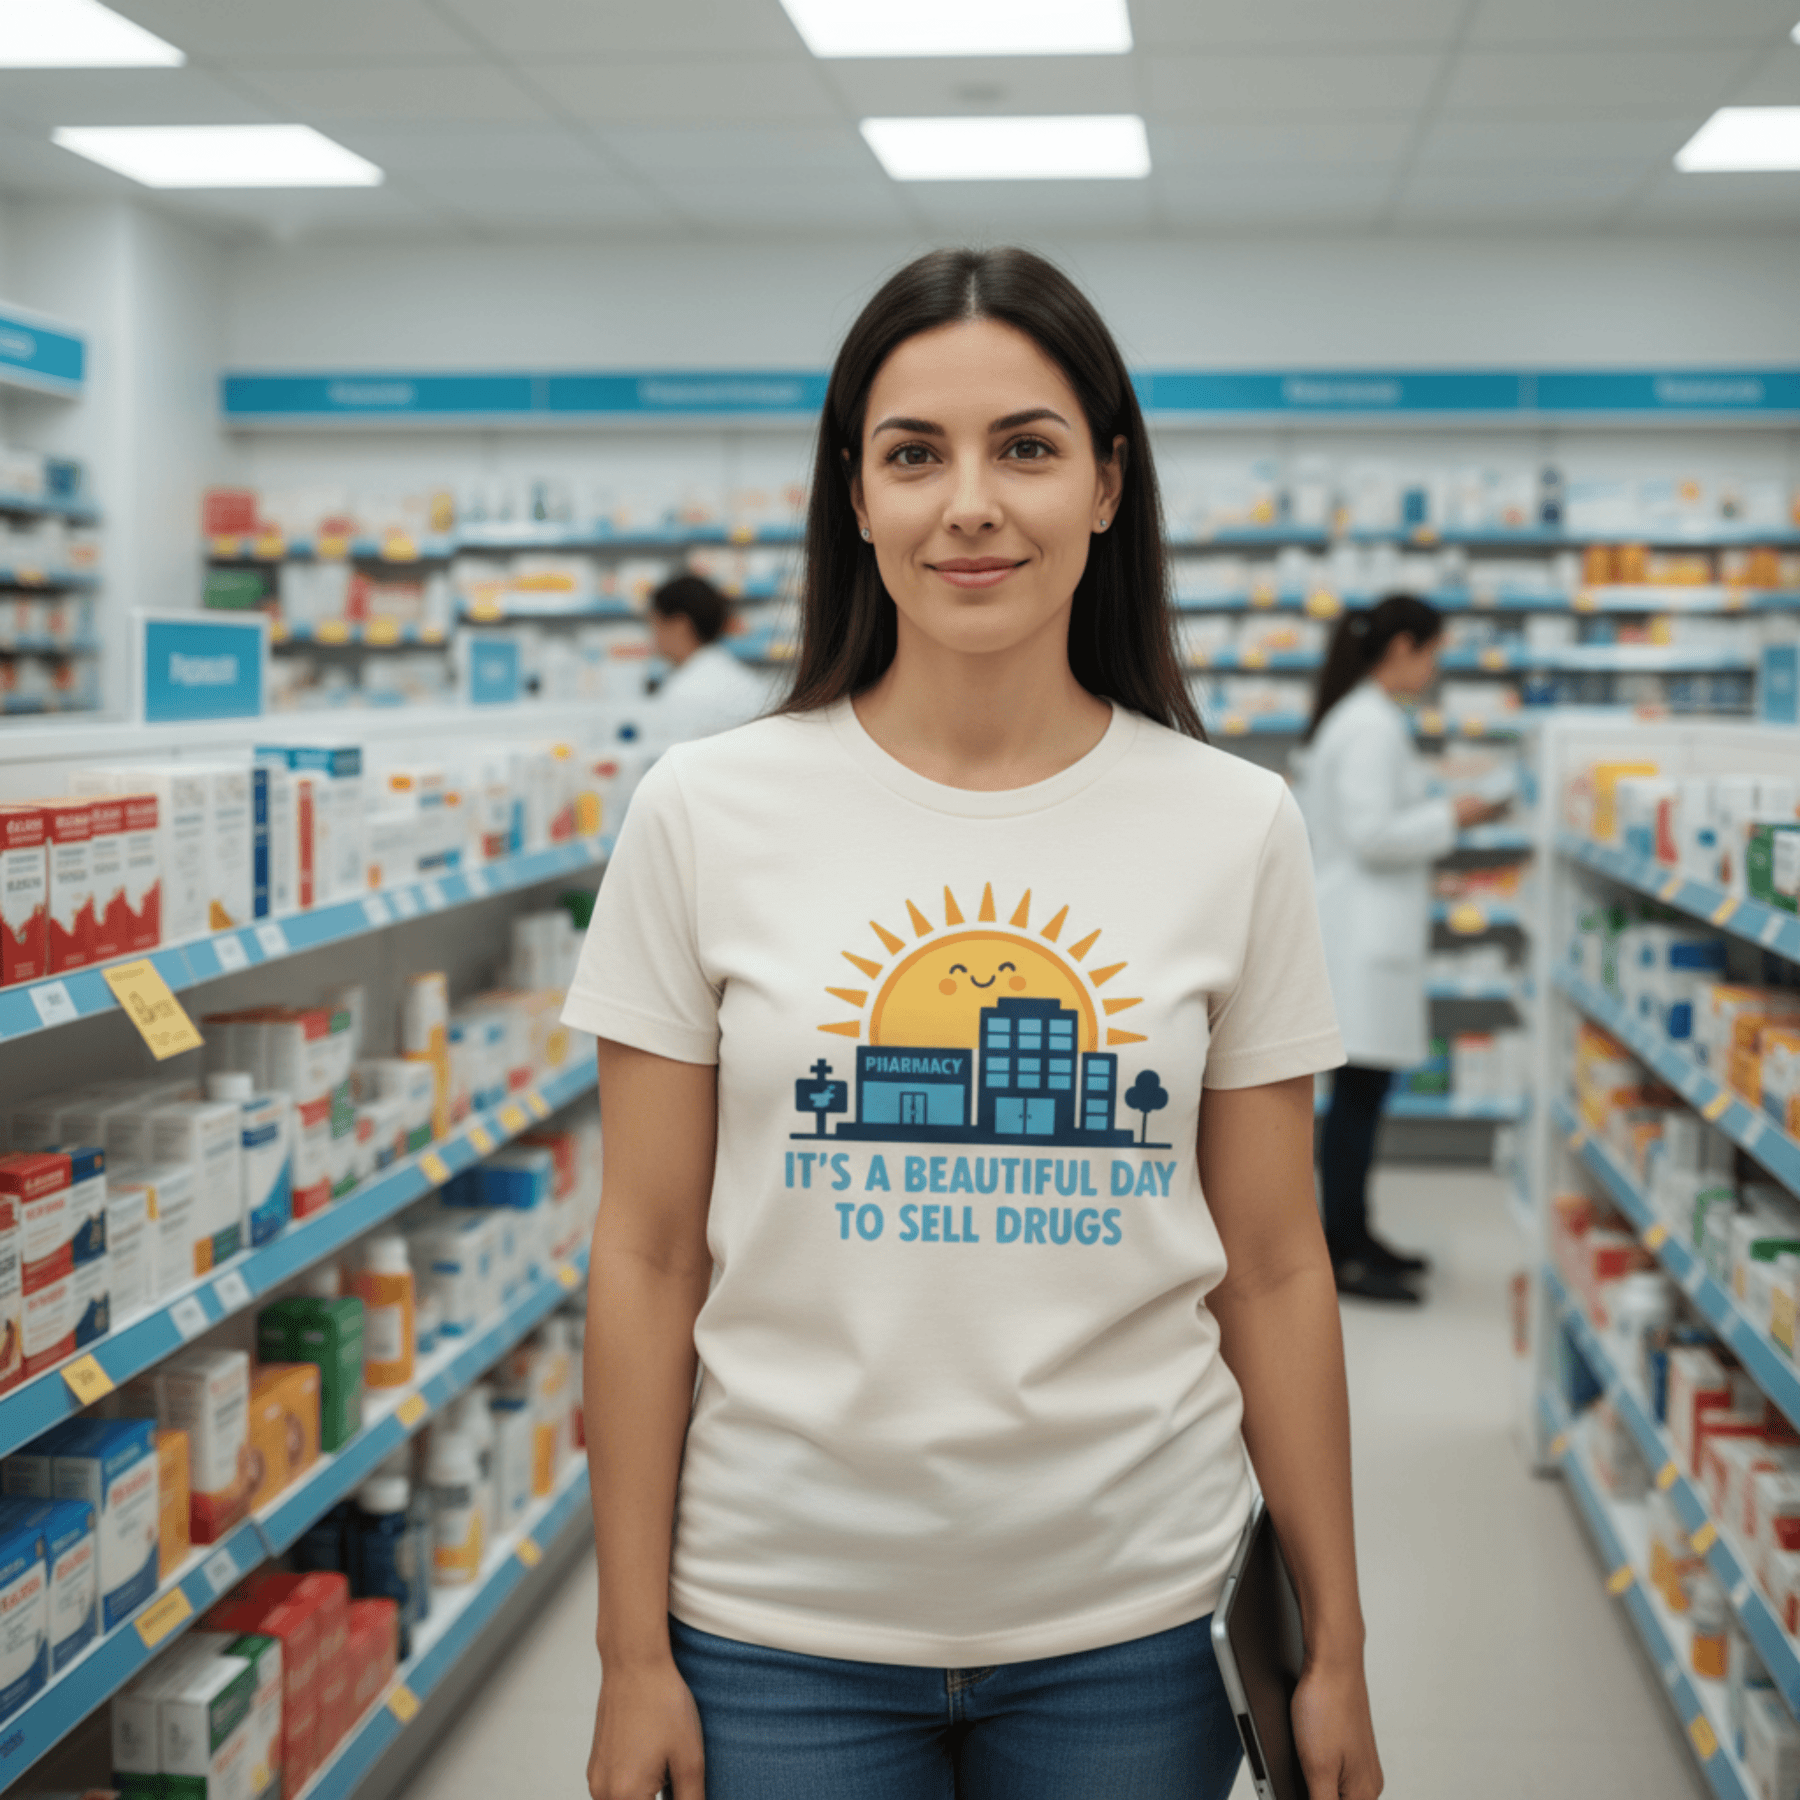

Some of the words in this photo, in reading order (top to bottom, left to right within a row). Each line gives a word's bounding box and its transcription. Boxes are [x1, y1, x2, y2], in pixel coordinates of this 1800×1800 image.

[865, 1056, 964, 1075] PHARMACY
[785, 1151, 852, 1191] IT'S
[864, 1154, 891, 1192] A
[904, 1155, 1097, 1197] BEAUTIFUL
[1110, 1160, 1178, 1198] DAY
[835, 1202, 885, 1241] TO
[899, 1204, 980, 1243] SELL
[996, 1206, 1123, 1246] DRUGS
